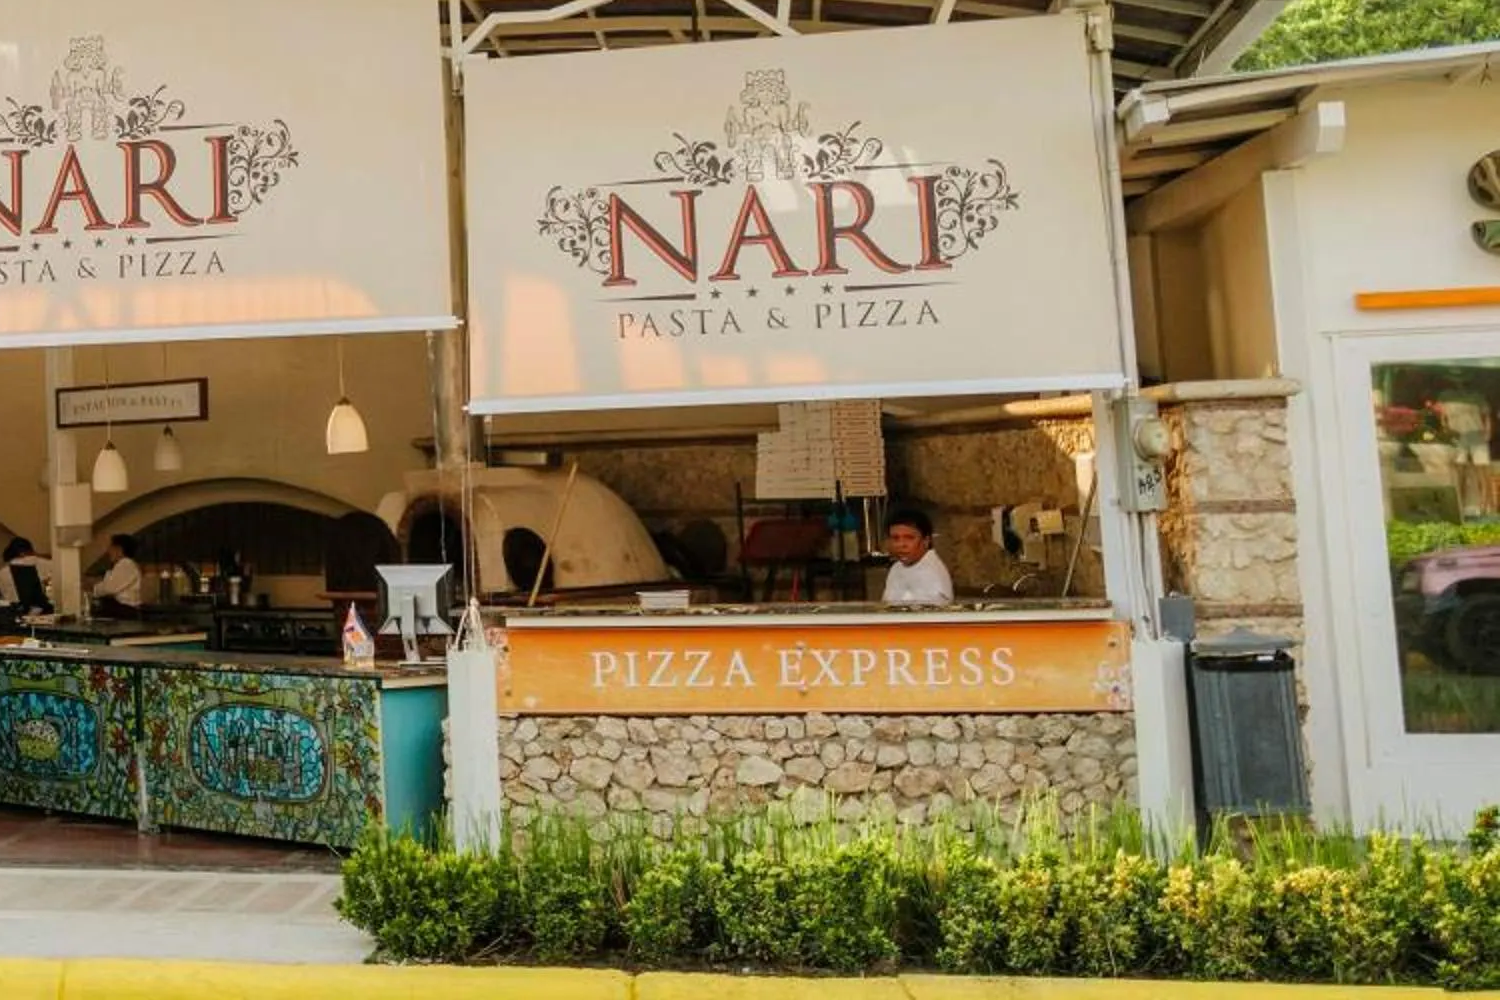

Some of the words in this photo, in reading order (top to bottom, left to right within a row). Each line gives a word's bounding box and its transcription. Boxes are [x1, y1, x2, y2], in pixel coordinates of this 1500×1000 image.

[601, 175, 952, 287] NARI
[76, 257, 101, 280] &
[118, 250, 226, 279] PIZZA
[618, 307, 743, 339] PASTA
[766, 306, 790, 330] &
[814, 298, 940, 330] PIZZA
[591, 650, 756, 689] PIZZA
[779, 647, 1017, 689] EXPRESS
